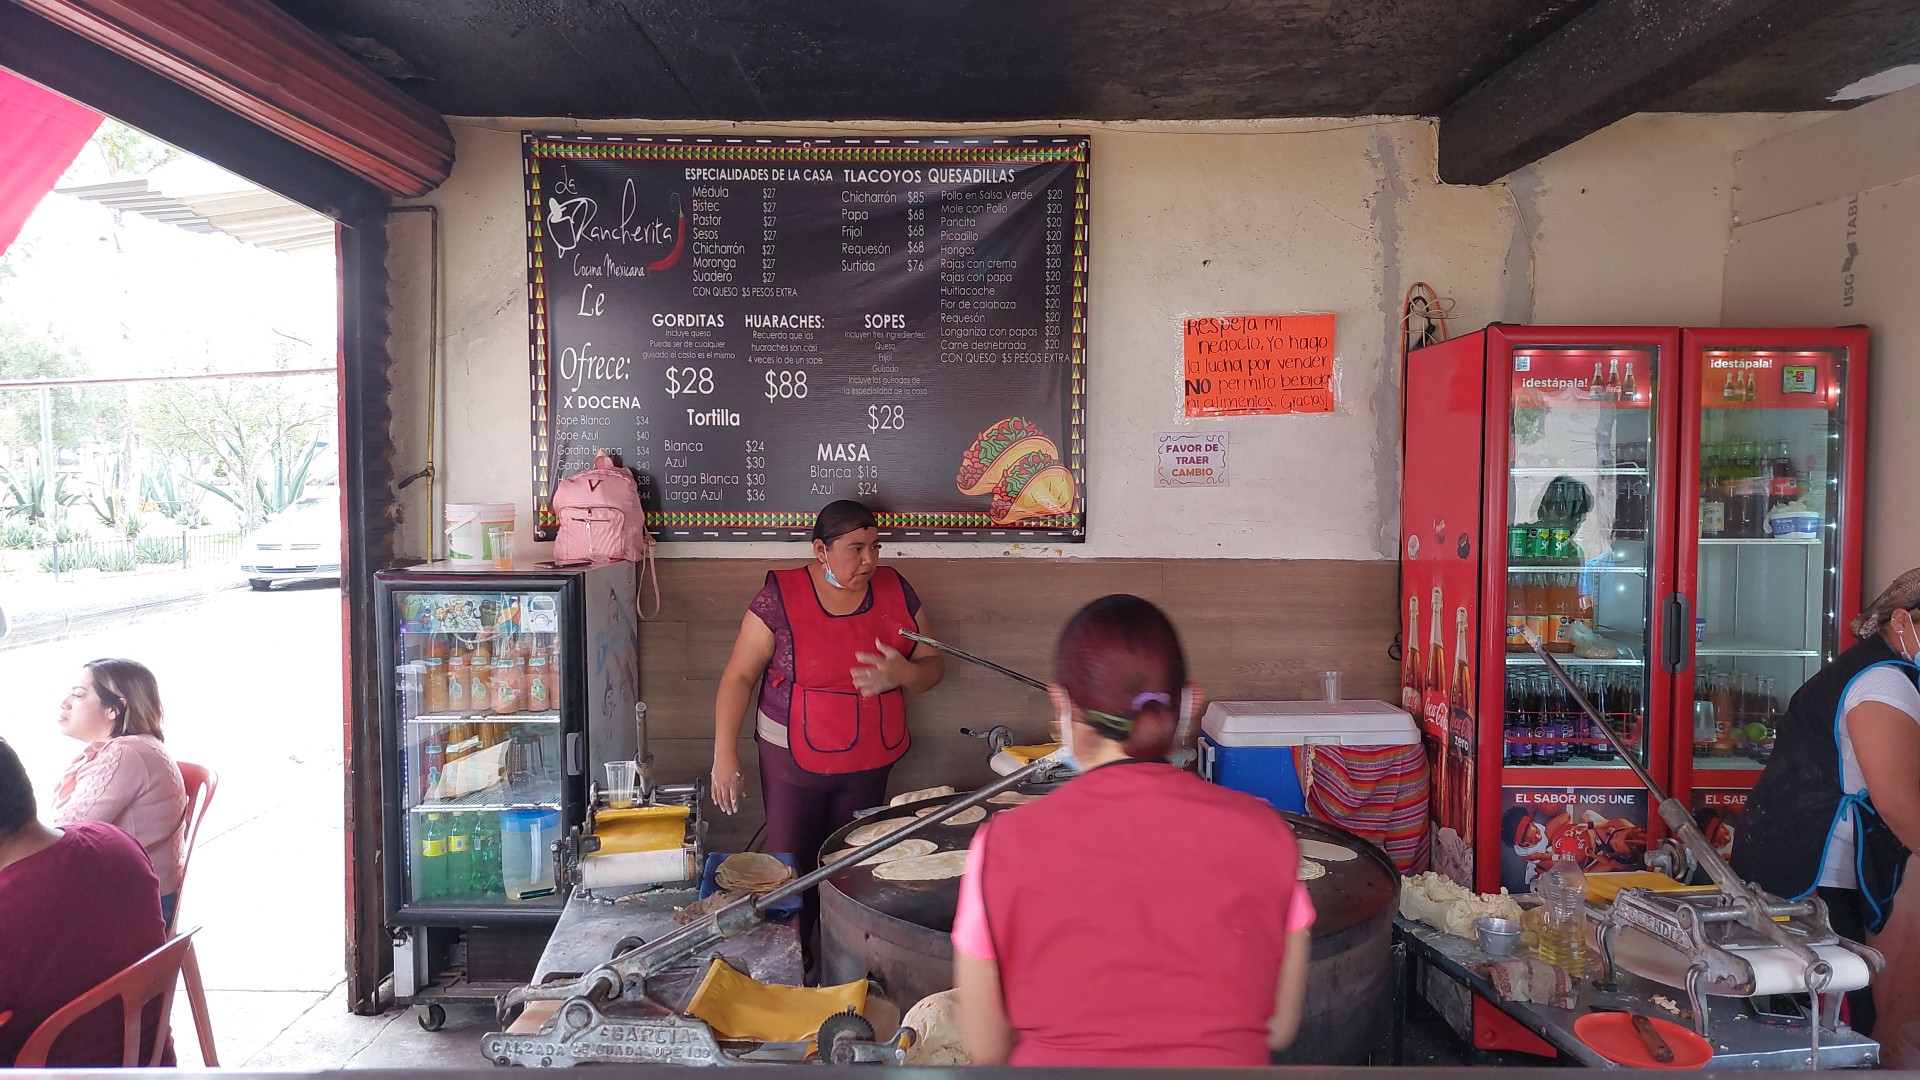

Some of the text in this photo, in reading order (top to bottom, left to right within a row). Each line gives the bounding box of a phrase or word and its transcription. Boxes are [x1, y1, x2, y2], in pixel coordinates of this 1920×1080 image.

[685, 168, 833, 180] ESPECIALIDADES DE LA CASA
[844, 169, 921, 183] TLACOYOS
[928, 168, 1014, 183] QUESADILLAS
[692, 186, 776, 199] Médula $27
[841, 191, 924, 203] Chicharrón $85
[941, 191, 963, 200] Pollo
[979, 191, 1002, 200] Salsa
[1006, 190, 1033, 199] Verde
[1047, 189, 1062, 200] $20
[559, 178, 672, 244] Rancherita
[692, 200, 776, 213] Bistec $27
[941, 204, 964, 213] Mole
[987, 204, 1008, 213] Pollo
[1047, 203, 1062, 214] $20
[692, 214, 776, 227] Pastor $27
[841, 209, 924, 222] Papa $68
[941, 217, 1062, 228] Pancita $20
[692, 229, 776, 241] Sesos $27
[841, 225, 924, 240] Frijol $68
[941, 231, 1062, 241] Picadillo $20
[692, 242, 776, 255] Chicharrón $27
[841, 242, 924, 255] Requesón $68
[941, 245, 1062, 257] Hongos $20
[574, 254, 645, 277] Cocina Mexicana
[692, 257, 776, 270] Moronga $27
[841, 260, 924, 272] Surtida $76
[941, 259, 964, 270] Rajas
[1046, 258, 1061, 268] $20
[692, 271, 776, 283] Suadero $27
[941, 273, 964, 283] Rajas
[987, 274, 1012, 283] papa
[1046, 272, 1061, 282] $20
[692, 287, 797, 297] CON QUESO $5 PESOS EXTRA
[941, 285, 1061, 295] Huitlacoche $20
[1843, 274, 1854, 307] USG
[578, 284, 604, 316] Le
[941, 299, 1060, 309] Flor de calabaza $20
[652, 314, 724, 327] GORDITAS
[745, 315, 825, 328] HUARACHES:
[865, 315, 905, 329] SOPES
[941, 312, 1060, 324] Requesón $20
[666, 329, 689, 338] Incluye
[941, 327, 986, 338] Longaniza
[1009, 329, 1038, 338] papas
[1045, 326, 1060, 336] $20
[1187, 317, 1283, 337] Respeta mi
[941, 339, 1060, 350] Carne deshebrada $20
[1289, 335, 1328, 354] hago
[941, 353, 1070, 363] CON QUESO $5 PESOS EXTRA
[1711, 359, 1772, 369] ¡destápala!
[560, 342, 631, 392] Ofrece:
[1188, 355, 1328, 376] la lucha por vender
[665, 366, 714, 399] $28
[764, 369, 807, 403] $88
[1185, 379, 1212, 396] NO
[1522, 378, 1587, 389] ¡destápala!
[564, 396, 641, 409] X DOCENA
[556, 415, 578, 427] Sope
[636, 416, 649, 425] $34
[687, 409, 740, 426] Tortilla
[868, 404, 904, 434] $28
[556, 430, 650, 442] Sope Azul $40
[557, 445, 650, 456] Gordita $34
[665, 440, 764, 452] Blanca $24
[817, 444, 870, 461] MASA
[1166, 444, 1218, 453] FAVOR DE
[557, 460, 650, 470] Gordita $40
[665, 457, 765, 469] Azul $30
[811, 465, 877, 480] Blanca $18
[1172, 468, 1213, 476] CAMBIO
[638, 476, 650, 485] $38
[665, 473, 765, 486] Larga Blanca $30
[665, 489, 765, 502] Larga Azul $36
[811, 482, 877, 497] Azul $24
[1455, 736, 1468, 751] zero
[1516, 794, 1634, 804] EL SABOR NOS UNE
[1706, 795, 1720, 804] EL
[612, 1027, 691, 1044] GARCIA
[492, 1041, 565, 1056] CALZADA
